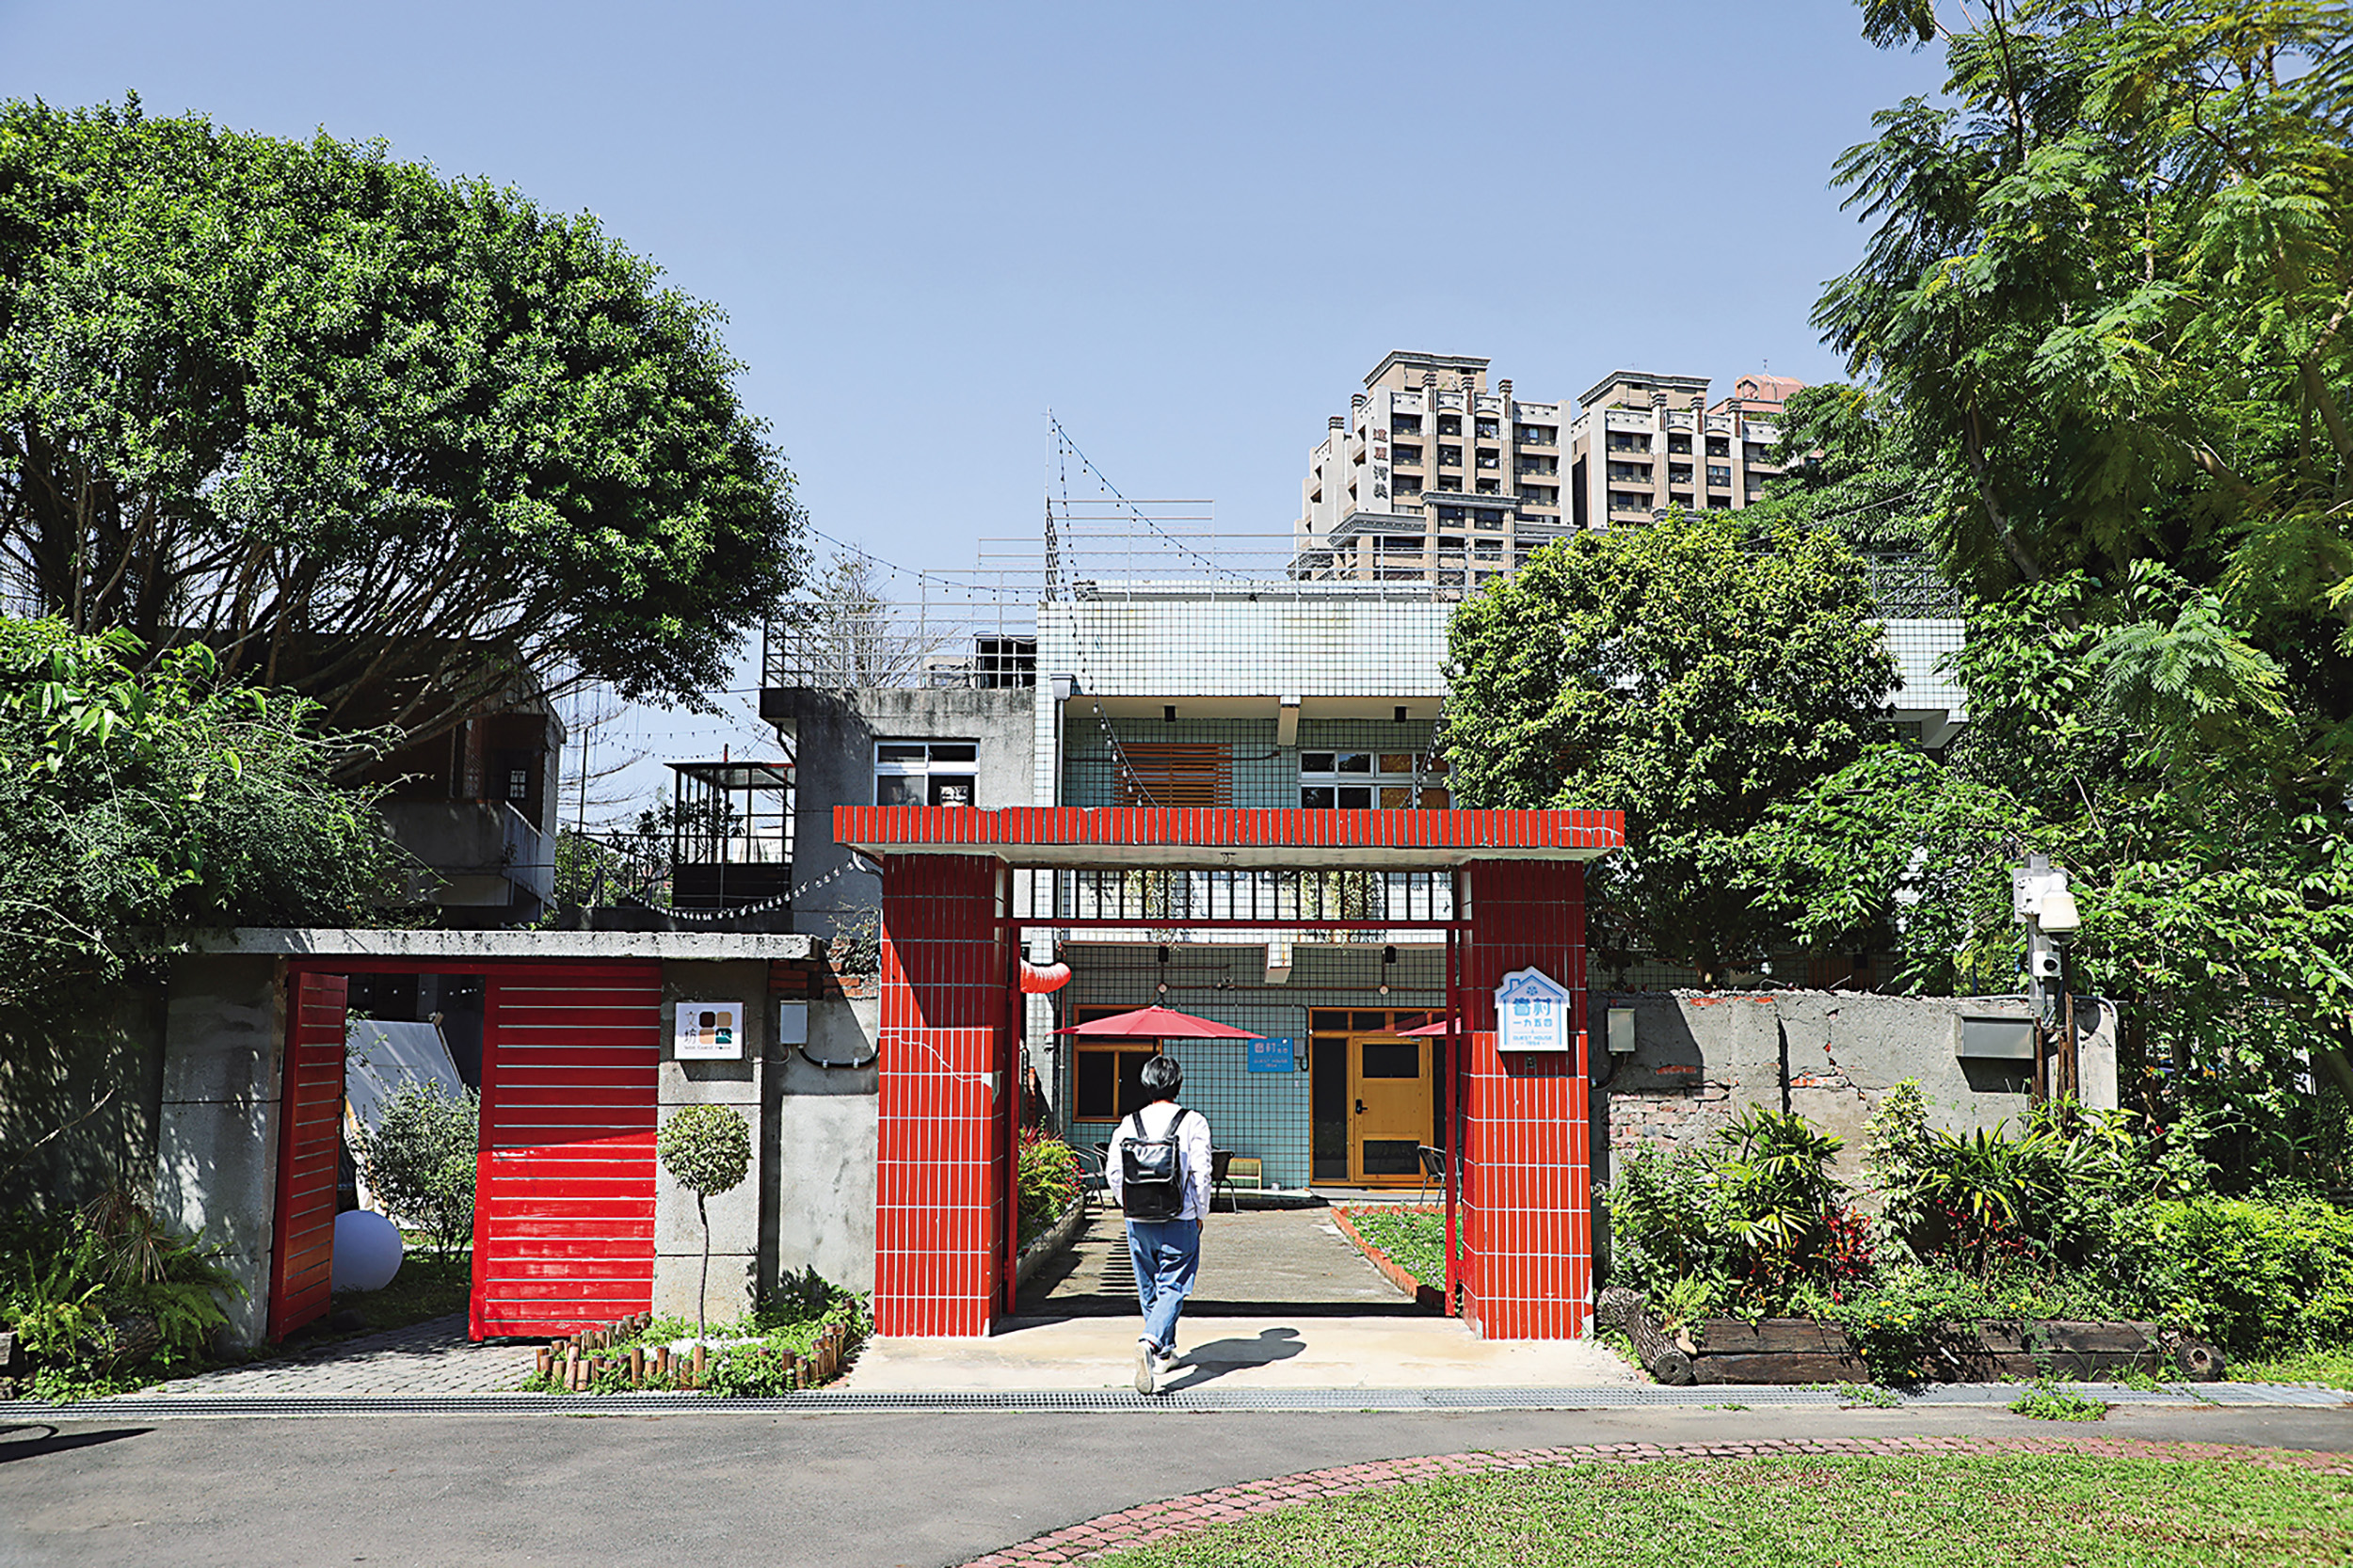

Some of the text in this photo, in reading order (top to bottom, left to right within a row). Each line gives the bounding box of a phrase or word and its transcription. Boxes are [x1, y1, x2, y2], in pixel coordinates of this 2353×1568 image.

[684, 1011, 696, 1045] 文坊
[1513, 1018, 1553, 1027] 一九五四
